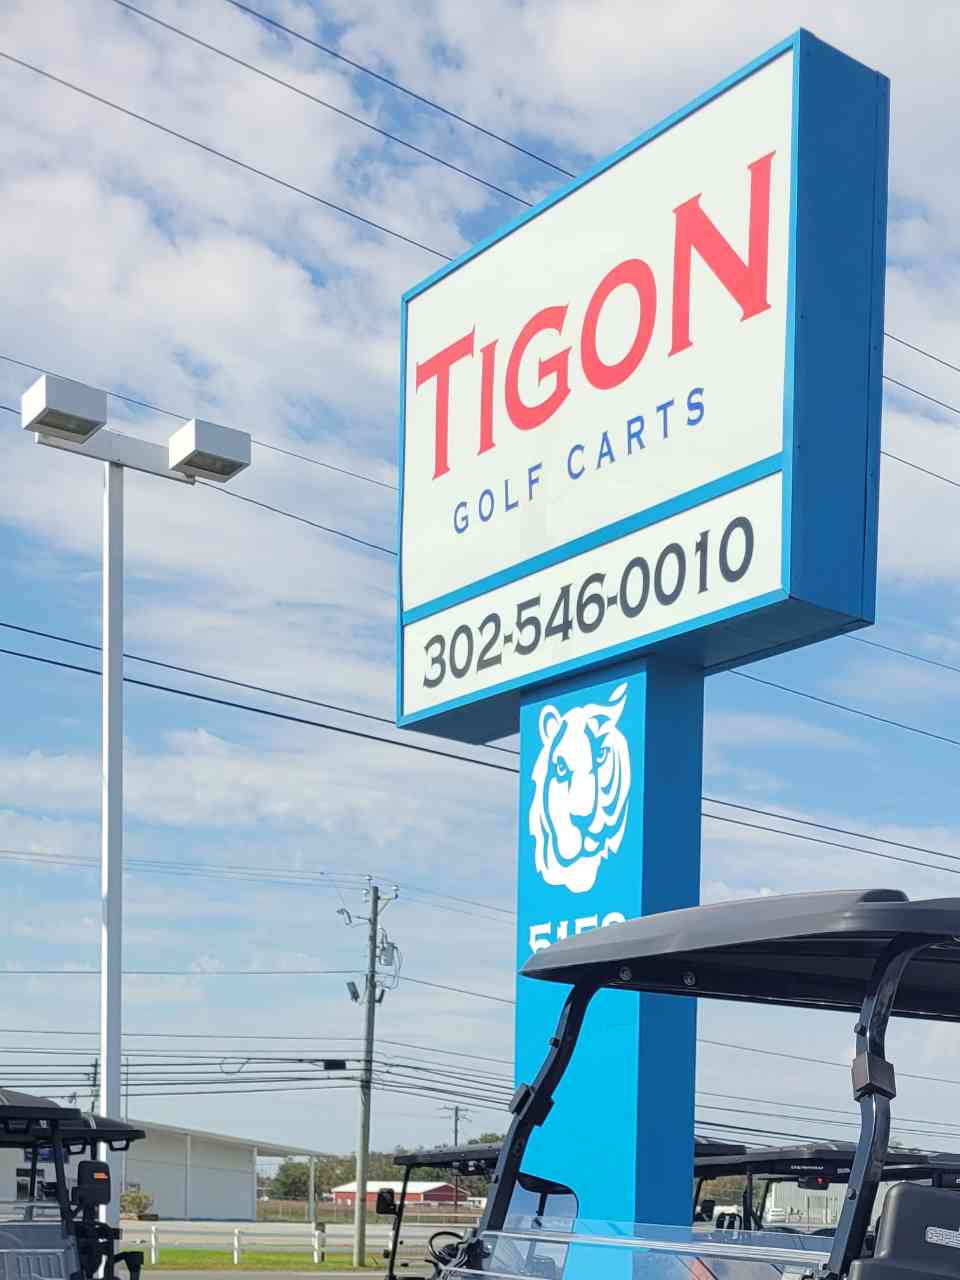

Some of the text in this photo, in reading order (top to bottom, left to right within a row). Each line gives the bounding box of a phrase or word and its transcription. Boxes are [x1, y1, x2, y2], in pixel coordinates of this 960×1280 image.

[415, 149, 776, 480] TIGON
[453, 387, 706, 535] GOLF CARTS
[422, 515, 755, 689] 302-546-0010
